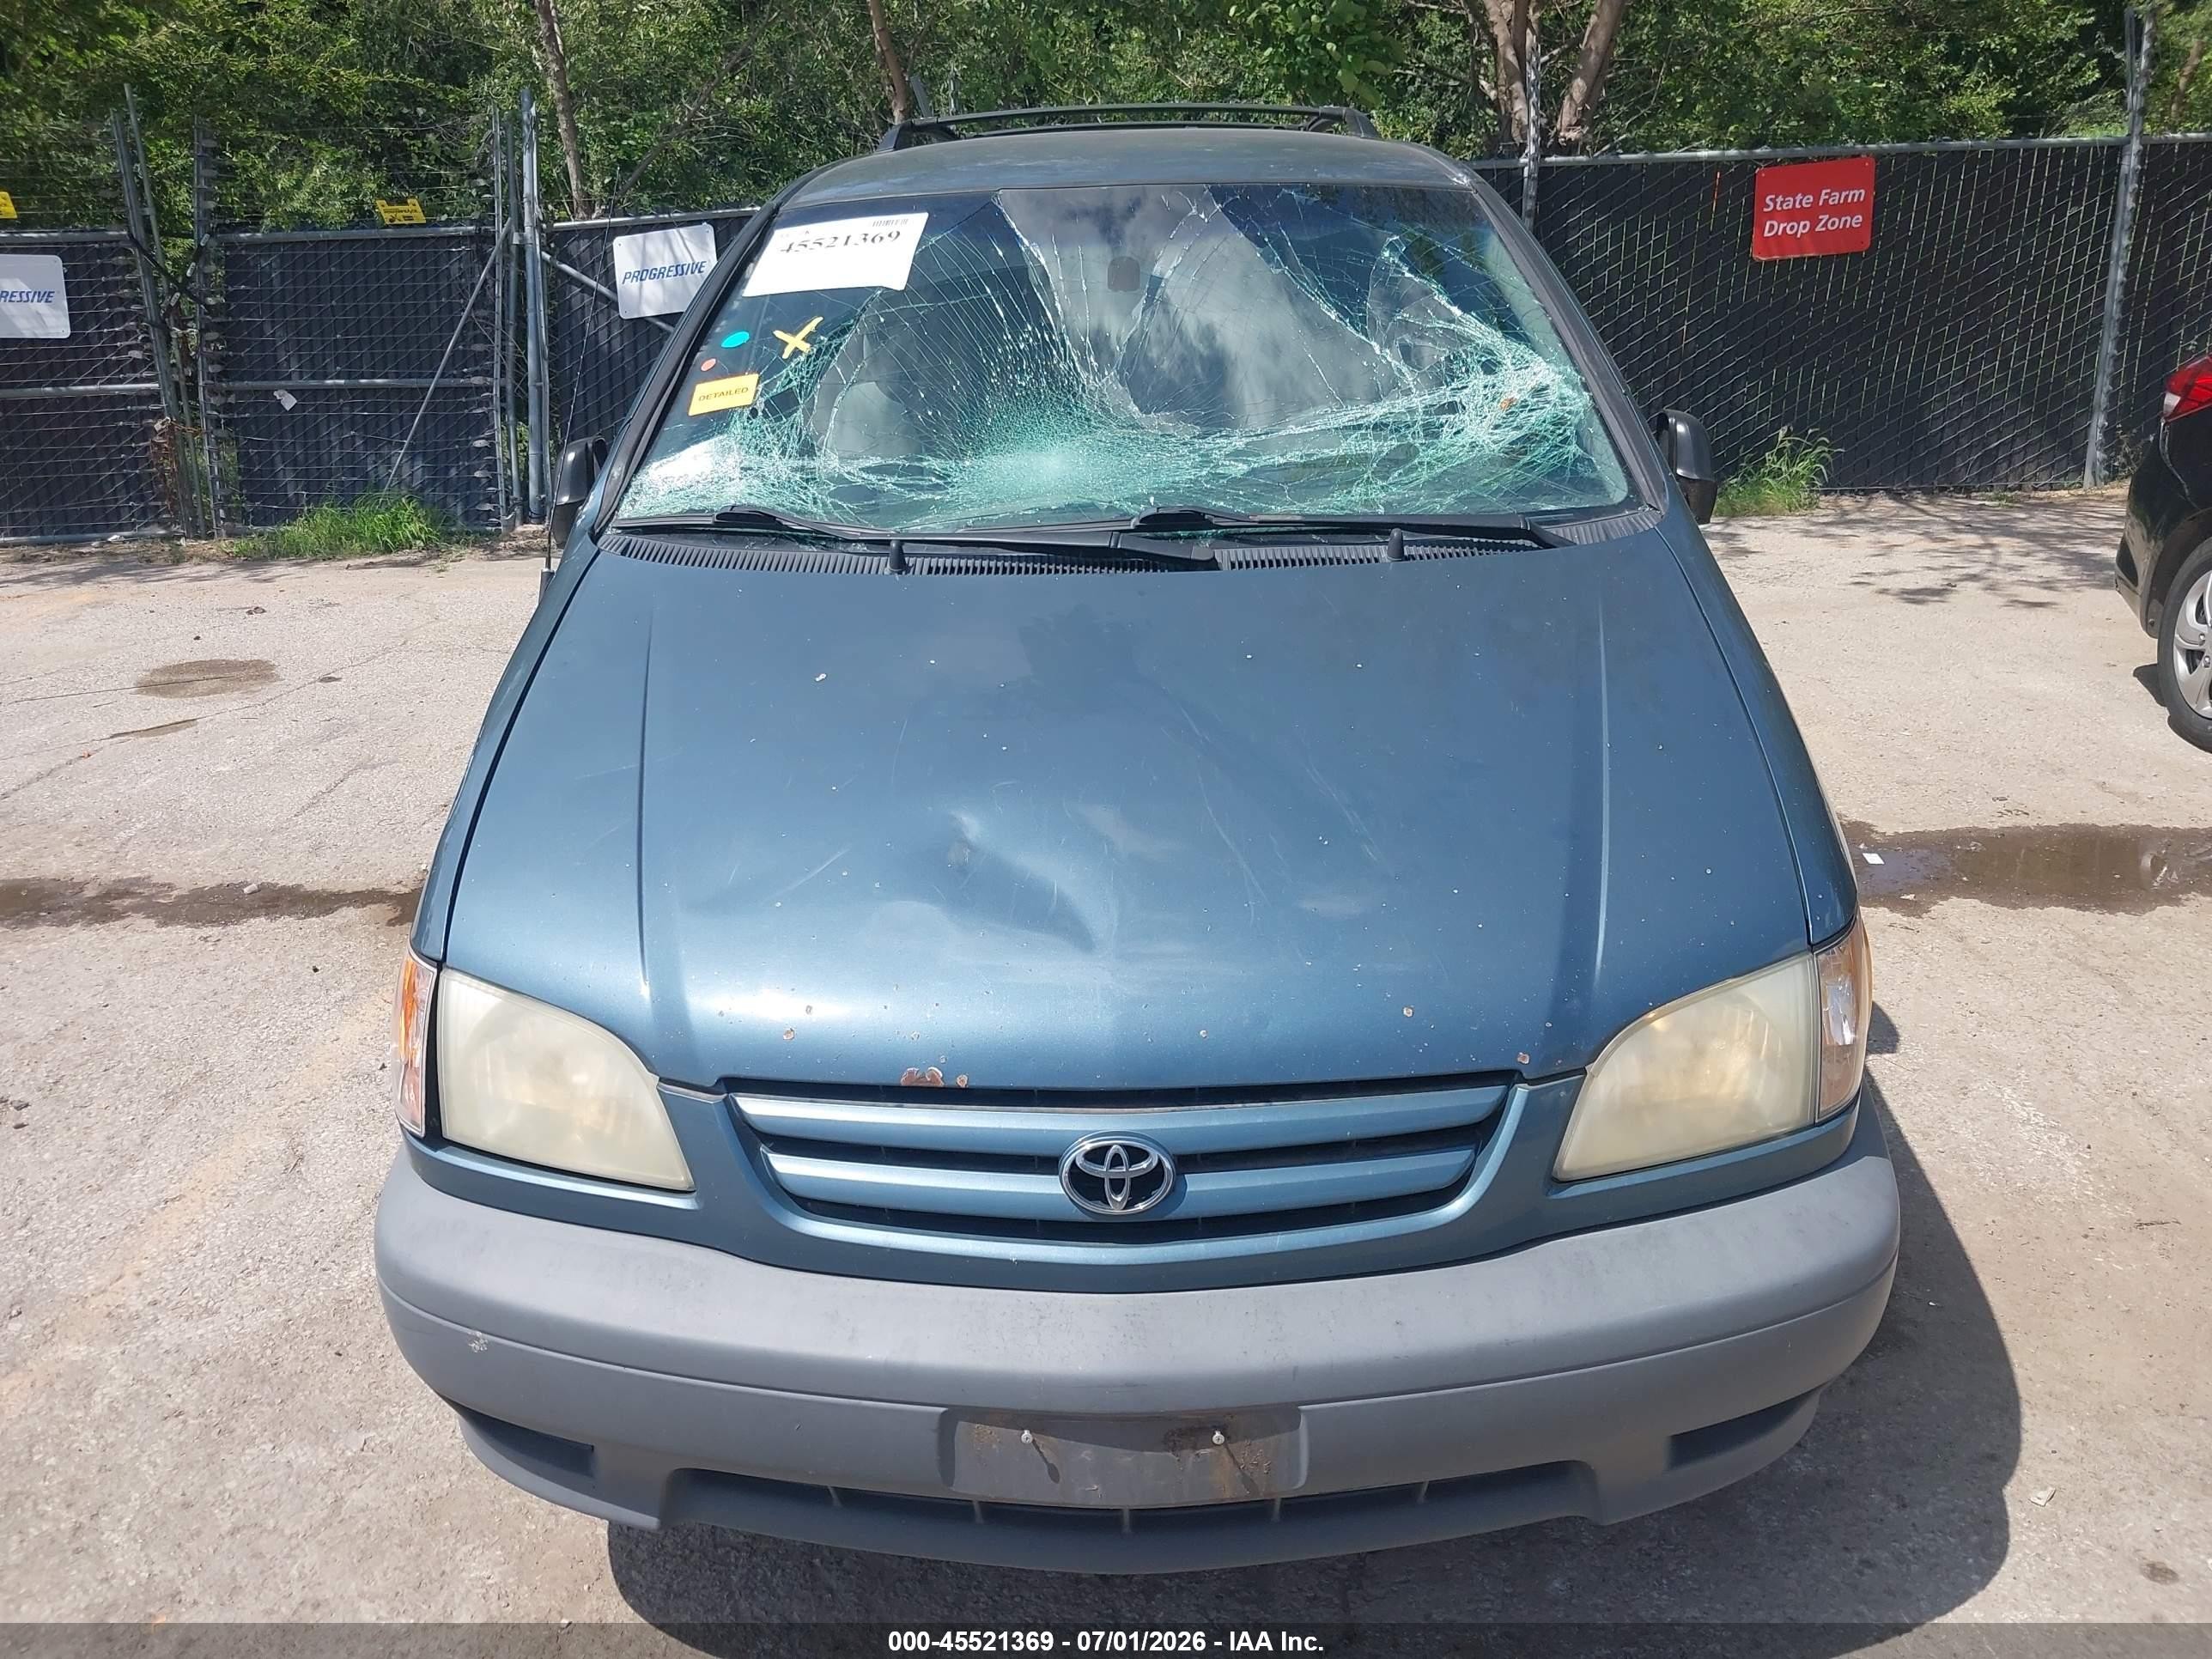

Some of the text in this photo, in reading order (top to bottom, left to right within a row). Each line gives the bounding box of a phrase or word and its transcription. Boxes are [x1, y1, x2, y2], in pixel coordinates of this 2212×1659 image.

[1763, 188, 1866, 212] State Farm
[1763, 215, 1863, 238] Drop Zone
[781, 230, 901, 252] 45521369
[622, 261, 707, 284] PROGRESSIVE
[698, 386, 749, 402] DETAILED
